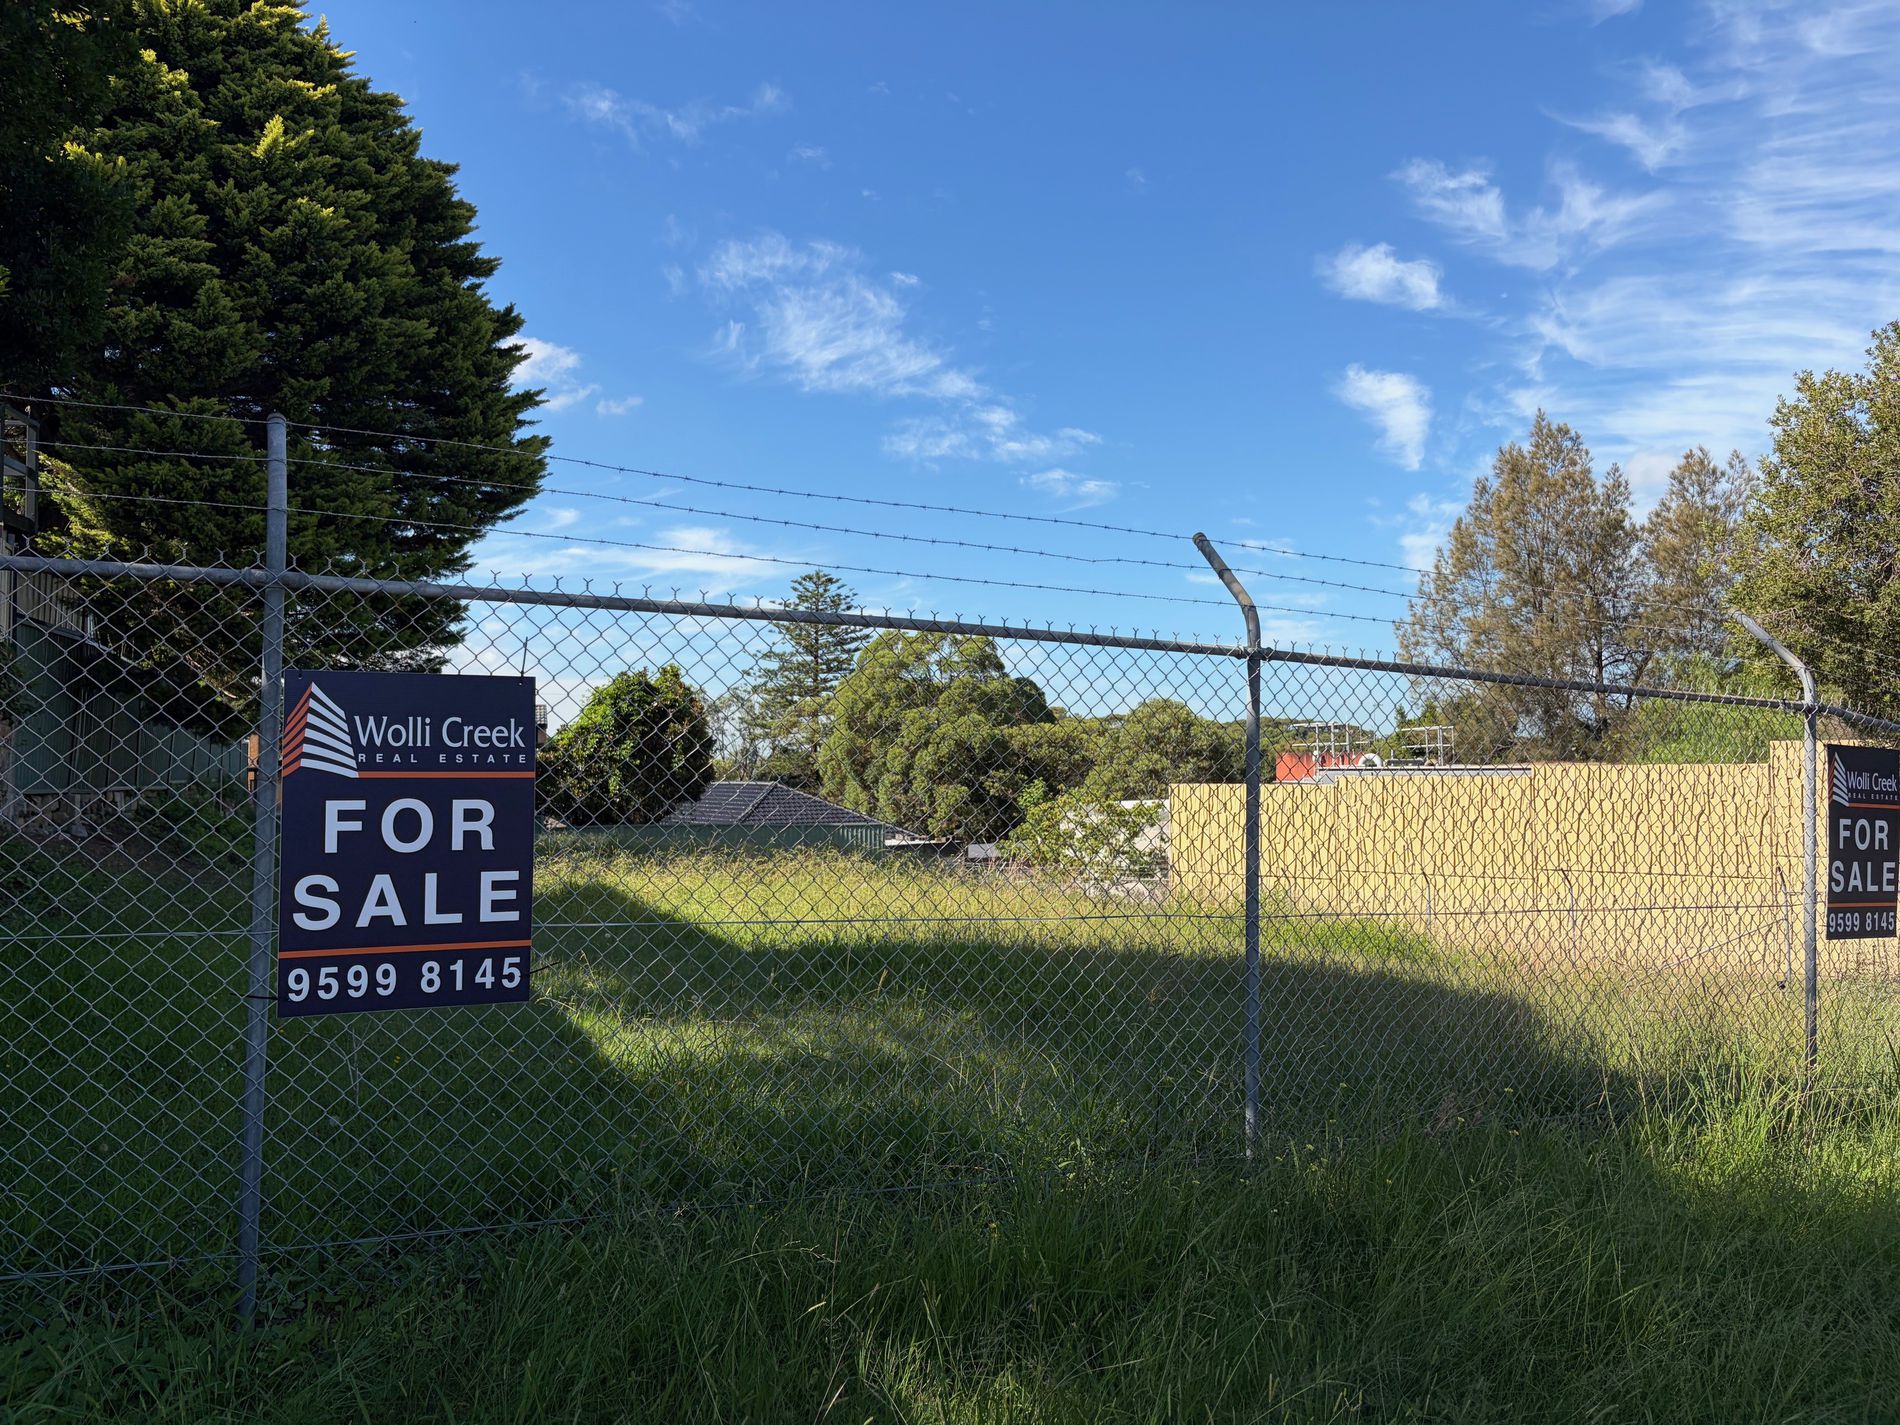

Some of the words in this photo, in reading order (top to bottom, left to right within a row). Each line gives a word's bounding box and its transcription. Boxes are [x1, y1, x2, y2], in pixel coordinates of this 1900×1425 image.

[354, 715, 431, 748] Wolli
[442, 716, 526, 748] Creek
[358, 753, 418, 763] REAL
[439, 753, 527, 764] ESTATE
[1847, 771, 1870, 790] Wolli
[1872, 772, 1898, 791] Creek
[1871, 793, 1899, 801] ESTATE
[324, 797, 496, 854] FOR
[1838, 818, 1889, 850] FOR
[1831, 861, 1896, 892] SALE
[292, 870, 521, 931] SALE
[1829, 912, 1860, 933] 9599
[1865, 911, 1895, 931] 8145
[287, 962, 398, 1002] 9599
[420, 956, 522, 993] 8145
